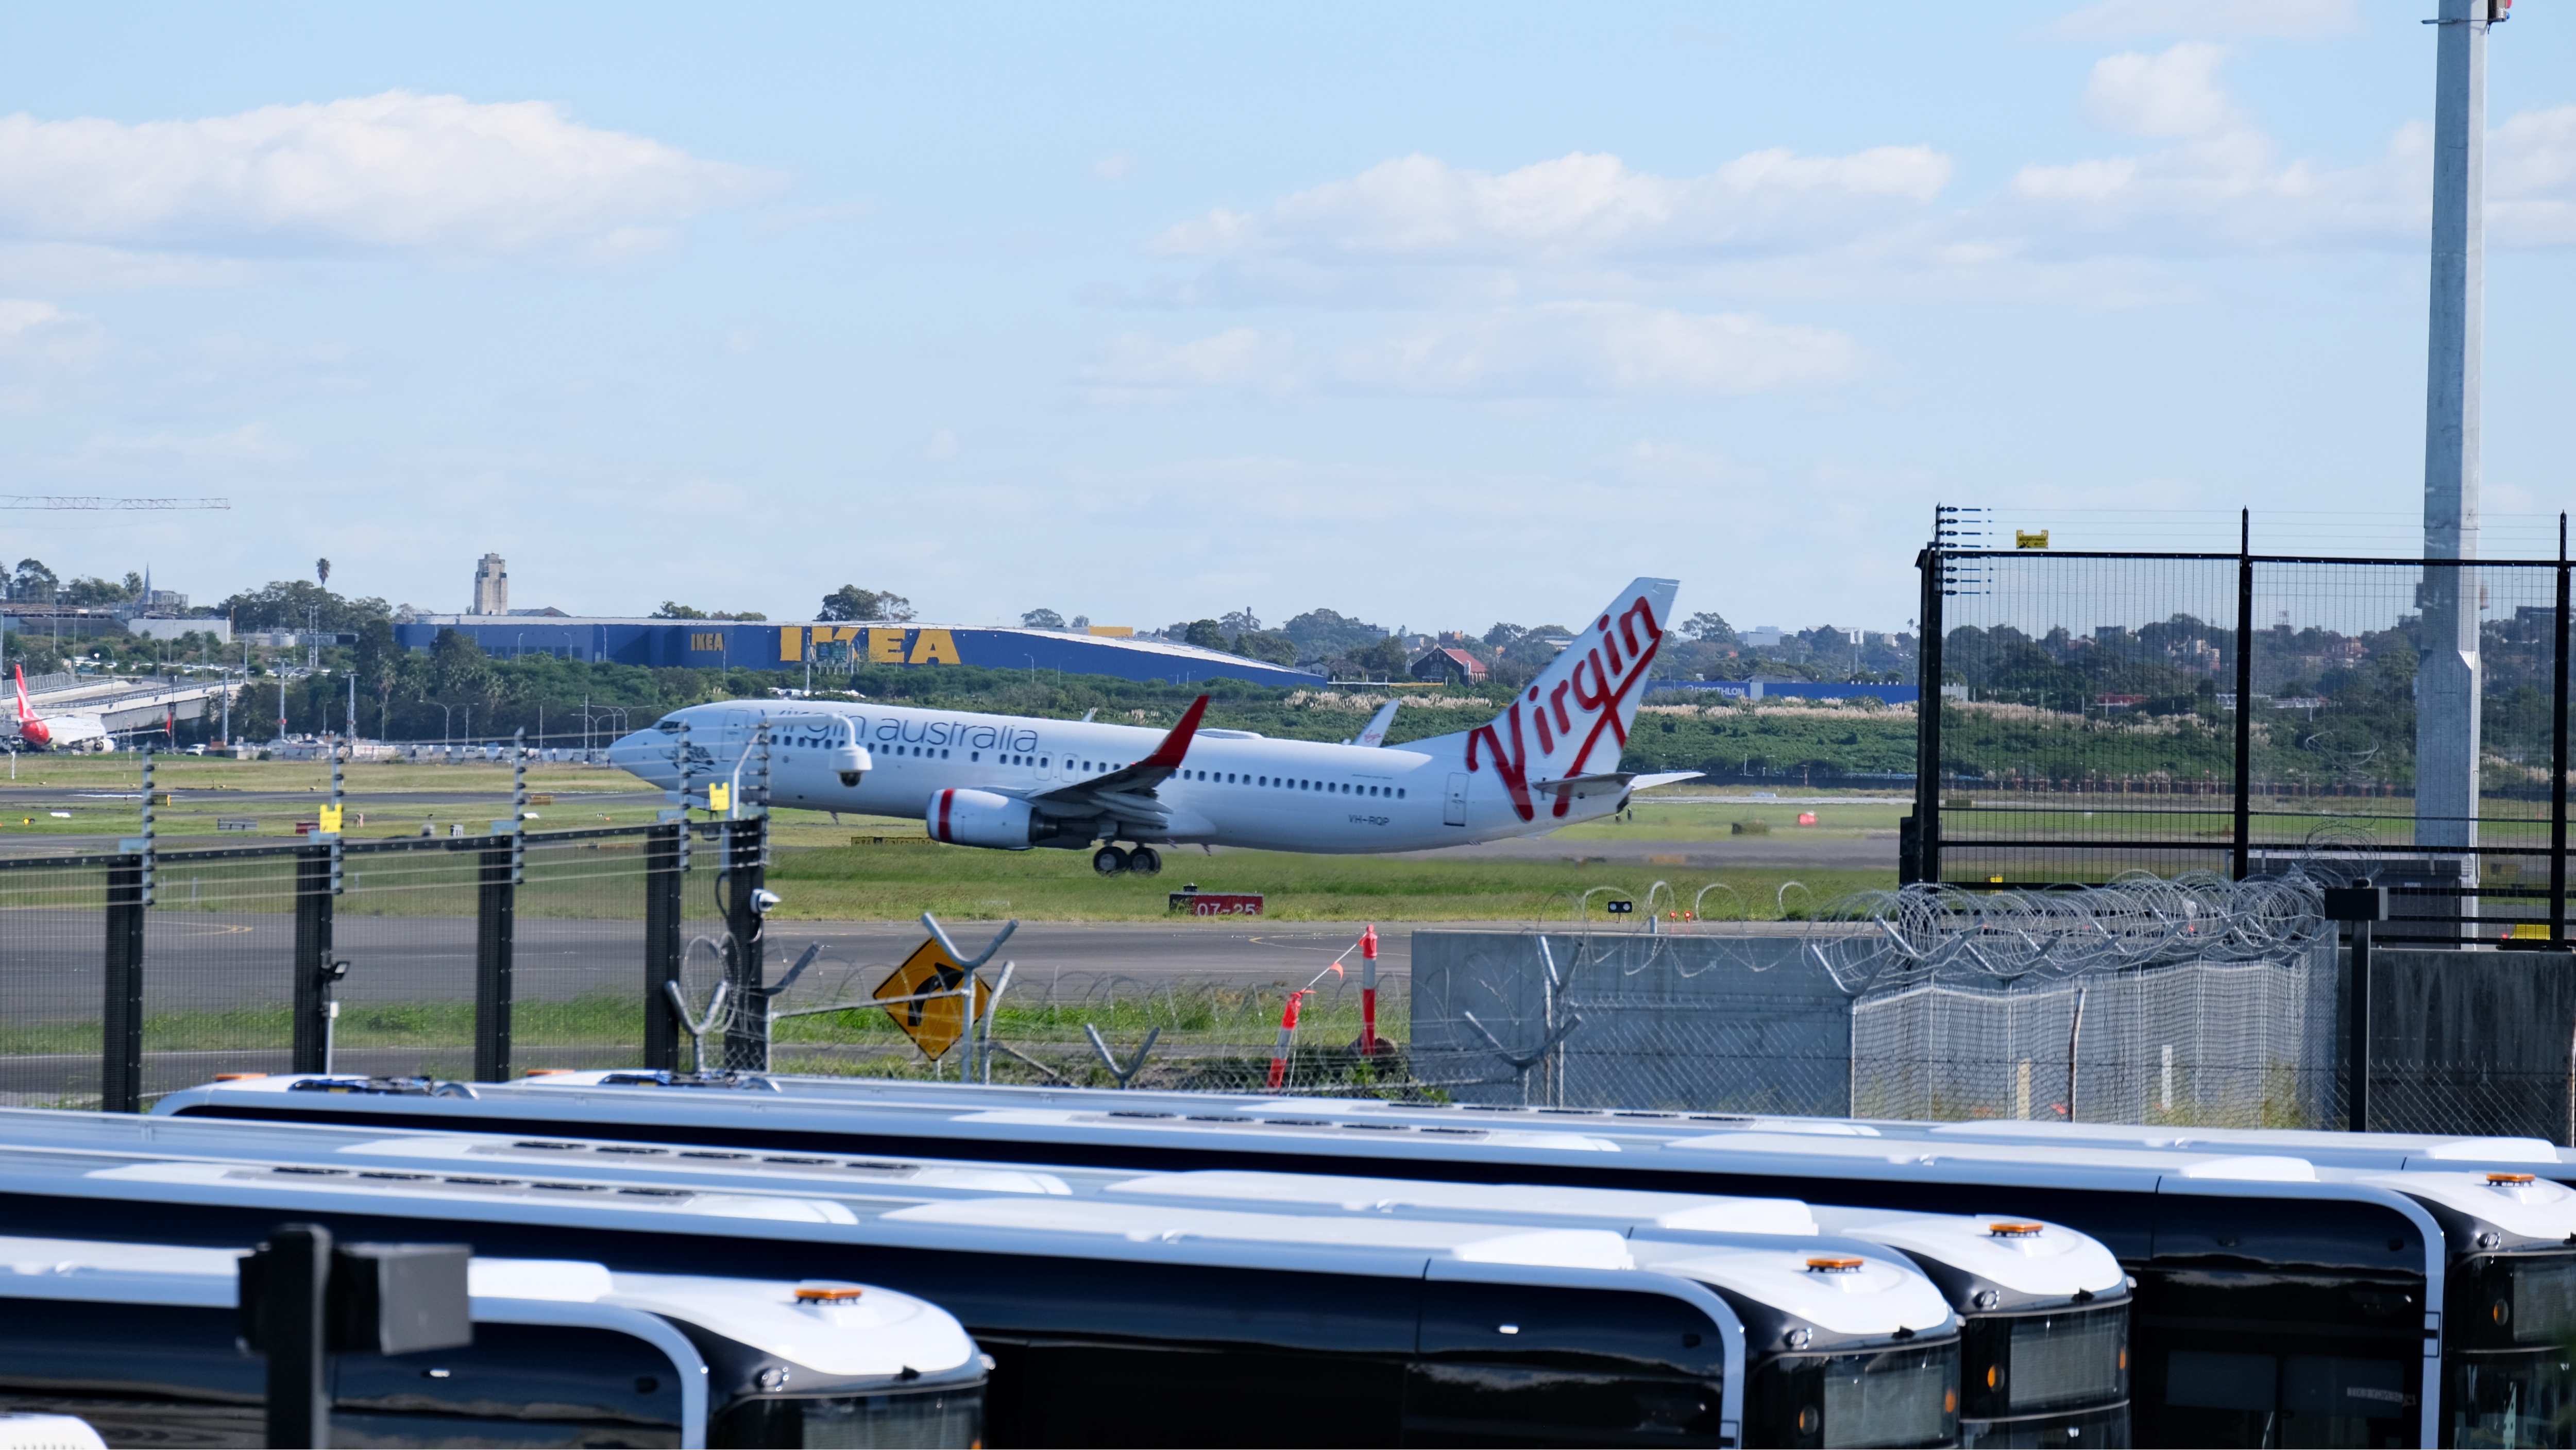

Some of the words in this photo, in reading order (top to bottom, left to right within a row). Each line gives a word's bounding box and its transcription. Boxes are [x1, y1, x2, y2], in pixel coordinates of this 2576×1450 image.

[690, 633, 723, 651] IKEA
[779, 626, 961, 664] IKEA
[1466, 595, 1663, 822] Virgin
[876, 718, 1038, 753] australia
[1348, 814, 1389, 826] VH-RQP
[1197, 902, 1256, 916] 07-25
